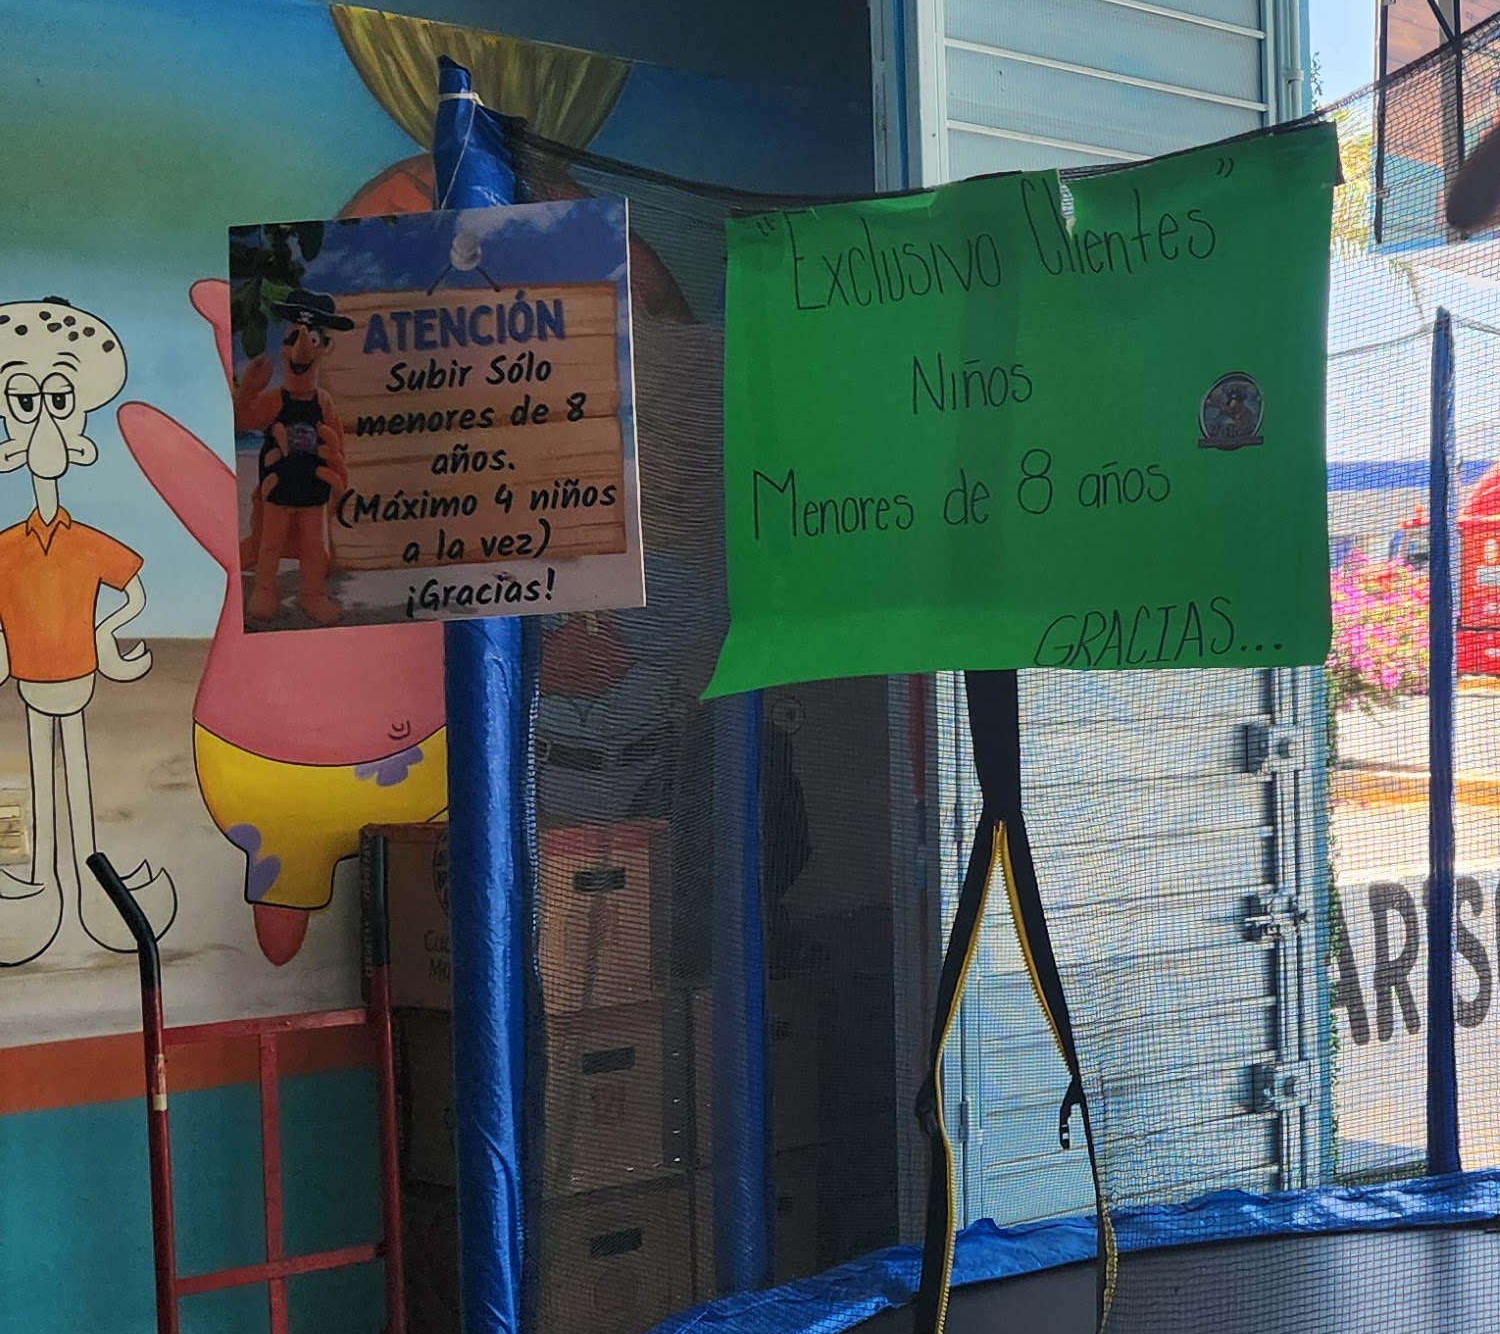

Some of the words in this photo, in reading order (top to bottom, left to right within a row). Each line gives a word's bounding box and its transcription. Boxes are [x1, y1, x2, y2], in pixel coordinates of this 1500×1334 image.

[362, 290, 566, 355] ATENCIÓN
[386, 358, 473, 393] Subir
[486, 351, 552, 386] Sólo
[912, 353, 1034, 415] Niños
[356, 405, 494, 438] menores
[511, 395, 549, 427] de
[566, 392, 587, 422] 8
[431, 446, 516, 477] años.
[336, 488, 478, 529] (Máximo
[494, 488, 513, 515] 4
[529, 480, 617, 511] niños
[752, 468, 914, 540] Menores
[943, 469, 990, 526] de
[1016, 448, 1054, 516] 8
[1077, 461, 1171, 509] años
[402, 543, 420, 564] a
[438, 528, 465, 560] la
[481, 517, 552, 558] vez)
[406, 568, 556, 619] ¡Gracias!
